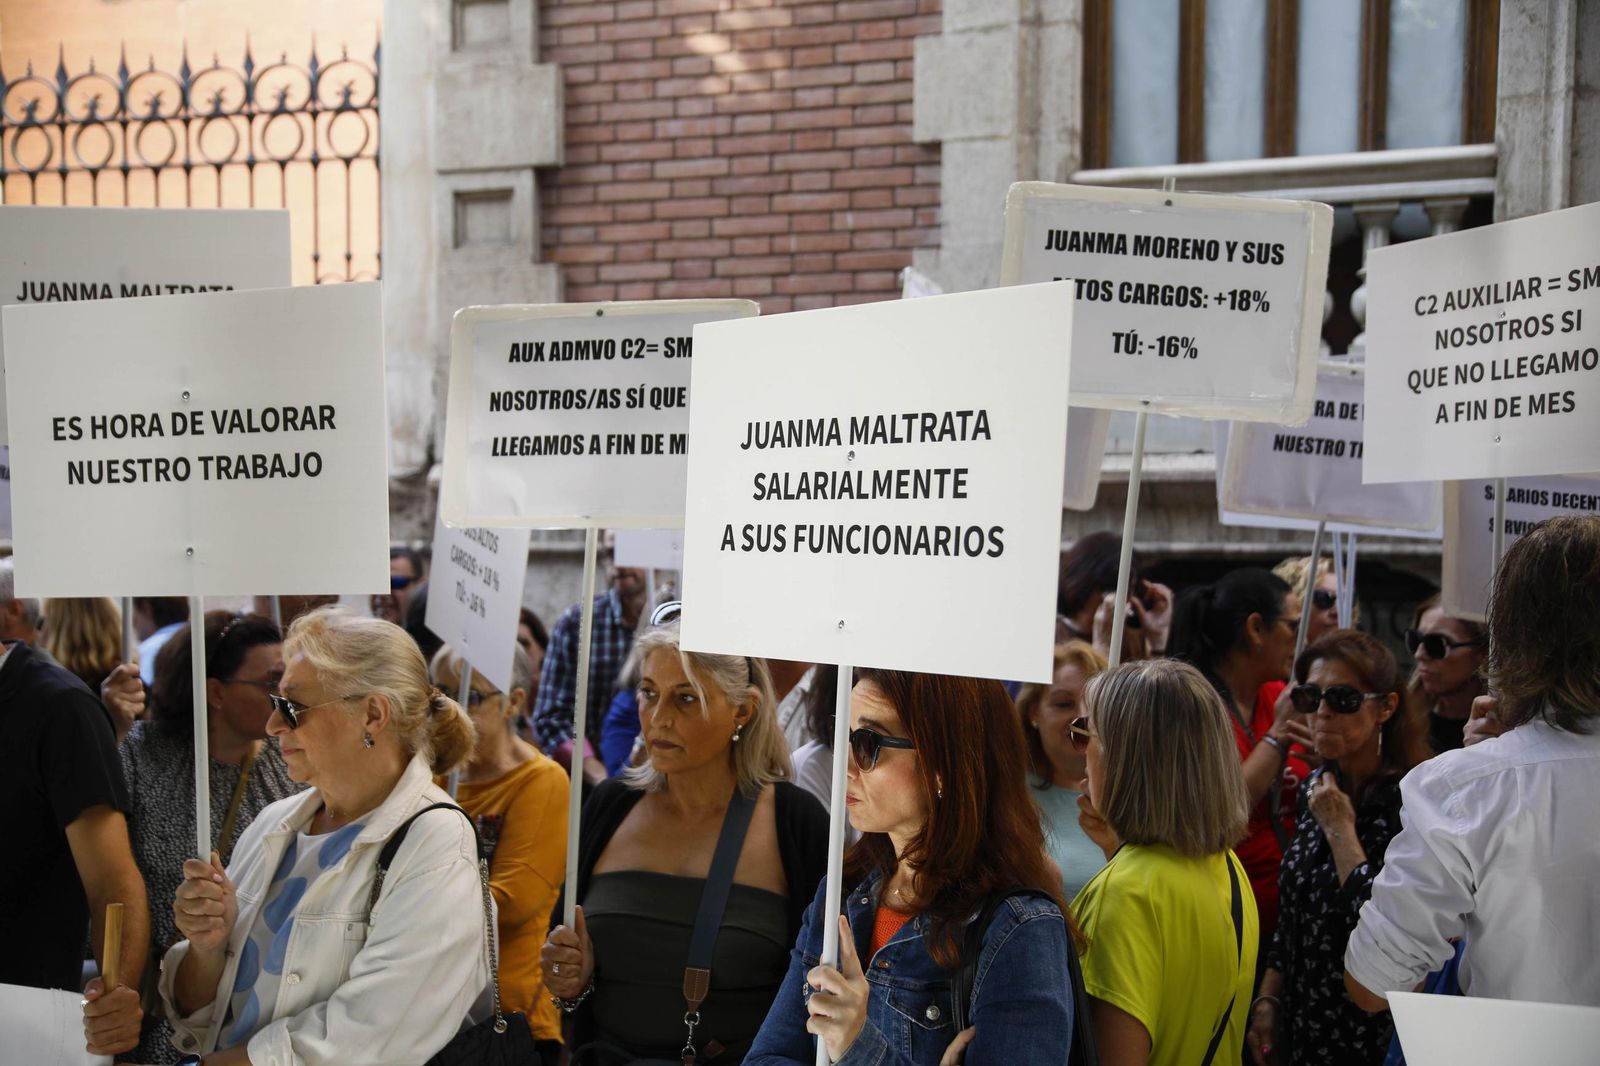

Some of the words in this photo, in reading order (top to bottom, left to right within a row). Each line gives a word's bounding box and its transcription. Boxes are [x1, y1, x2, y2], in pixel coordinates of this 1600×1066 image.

[1045, 230, 1127, 255] JUANMA
[1133, 235, 1219, 261] MORENO
[1226, 241, 1238, 262] Y
[1243, 242, 1284, 265] SUS
[17, 282, 112, 301] JUANMA
[1053, 277, 1112, 302] TOS
[1119, 282, 1208, 308] CARGOS:
[1214, 290, 1269, 312] +18%
[1415, 295, 1437, 316] C2
[1443, 277, 1541, 312] AUXILIAR
[1548, 278, 1561, 290] =
[1113, 330, 1143, 355] TÚ:
[1148, 336, 1197, 358] -16%
[1436, 314, 1554, 350] NOSOTROS
[1561, 310, 1581, 333] SI
[509, 342, 544, 362] AUX
[549, 339, 615, 361] ADMVO
[621, 338, 658, 359] C2=
[1408, 367, 1448, 394] QUE
[1455, 362, 1484, 384] NO
[490, 389, 620, 411] NOSOTROS/AS
[626, 384, 644, 408] SÍ
[650, 387, 686, 410] QUE
[1339, 402, 1358, 420] DE
[1436, 404, 1448, 423] A
[1455, 400, 1487, 422] FIN
[1495, 396, 1521, 418] DE
[1529, 391, 1575, 415] MES
[53, 417, 82, 440] ES
[91, 413, 164, 439] HORA
[172, 411, 204, 436] DE
[211, 405, 336, 434] VALORAR
[741, 418, 841, 450] JUANMA
[850, 410, 991, 445] MALTRATA
[492, 435, 584, 456] LLEGAMOS
[589, 435, 601, 454] A
[607, 434, 635, 454] FIN
[641, 434, 664, 454] DE
[669, 433, 689, 455] M
[1274, 435, 1345, 457] NUESTRO
[68, 457, 190, 484] NUESTRO
[198, 452, 322, 480] TRABAJO
[754, 468, 968, 500] SALARIALMENTE
[1485, 485, 1548, 506] SARIOS
[721, 524, 735, 551] A
[742, 524, 786, 552] SUS
[794, 525, 1004, 557] FUNCIONARIOS
